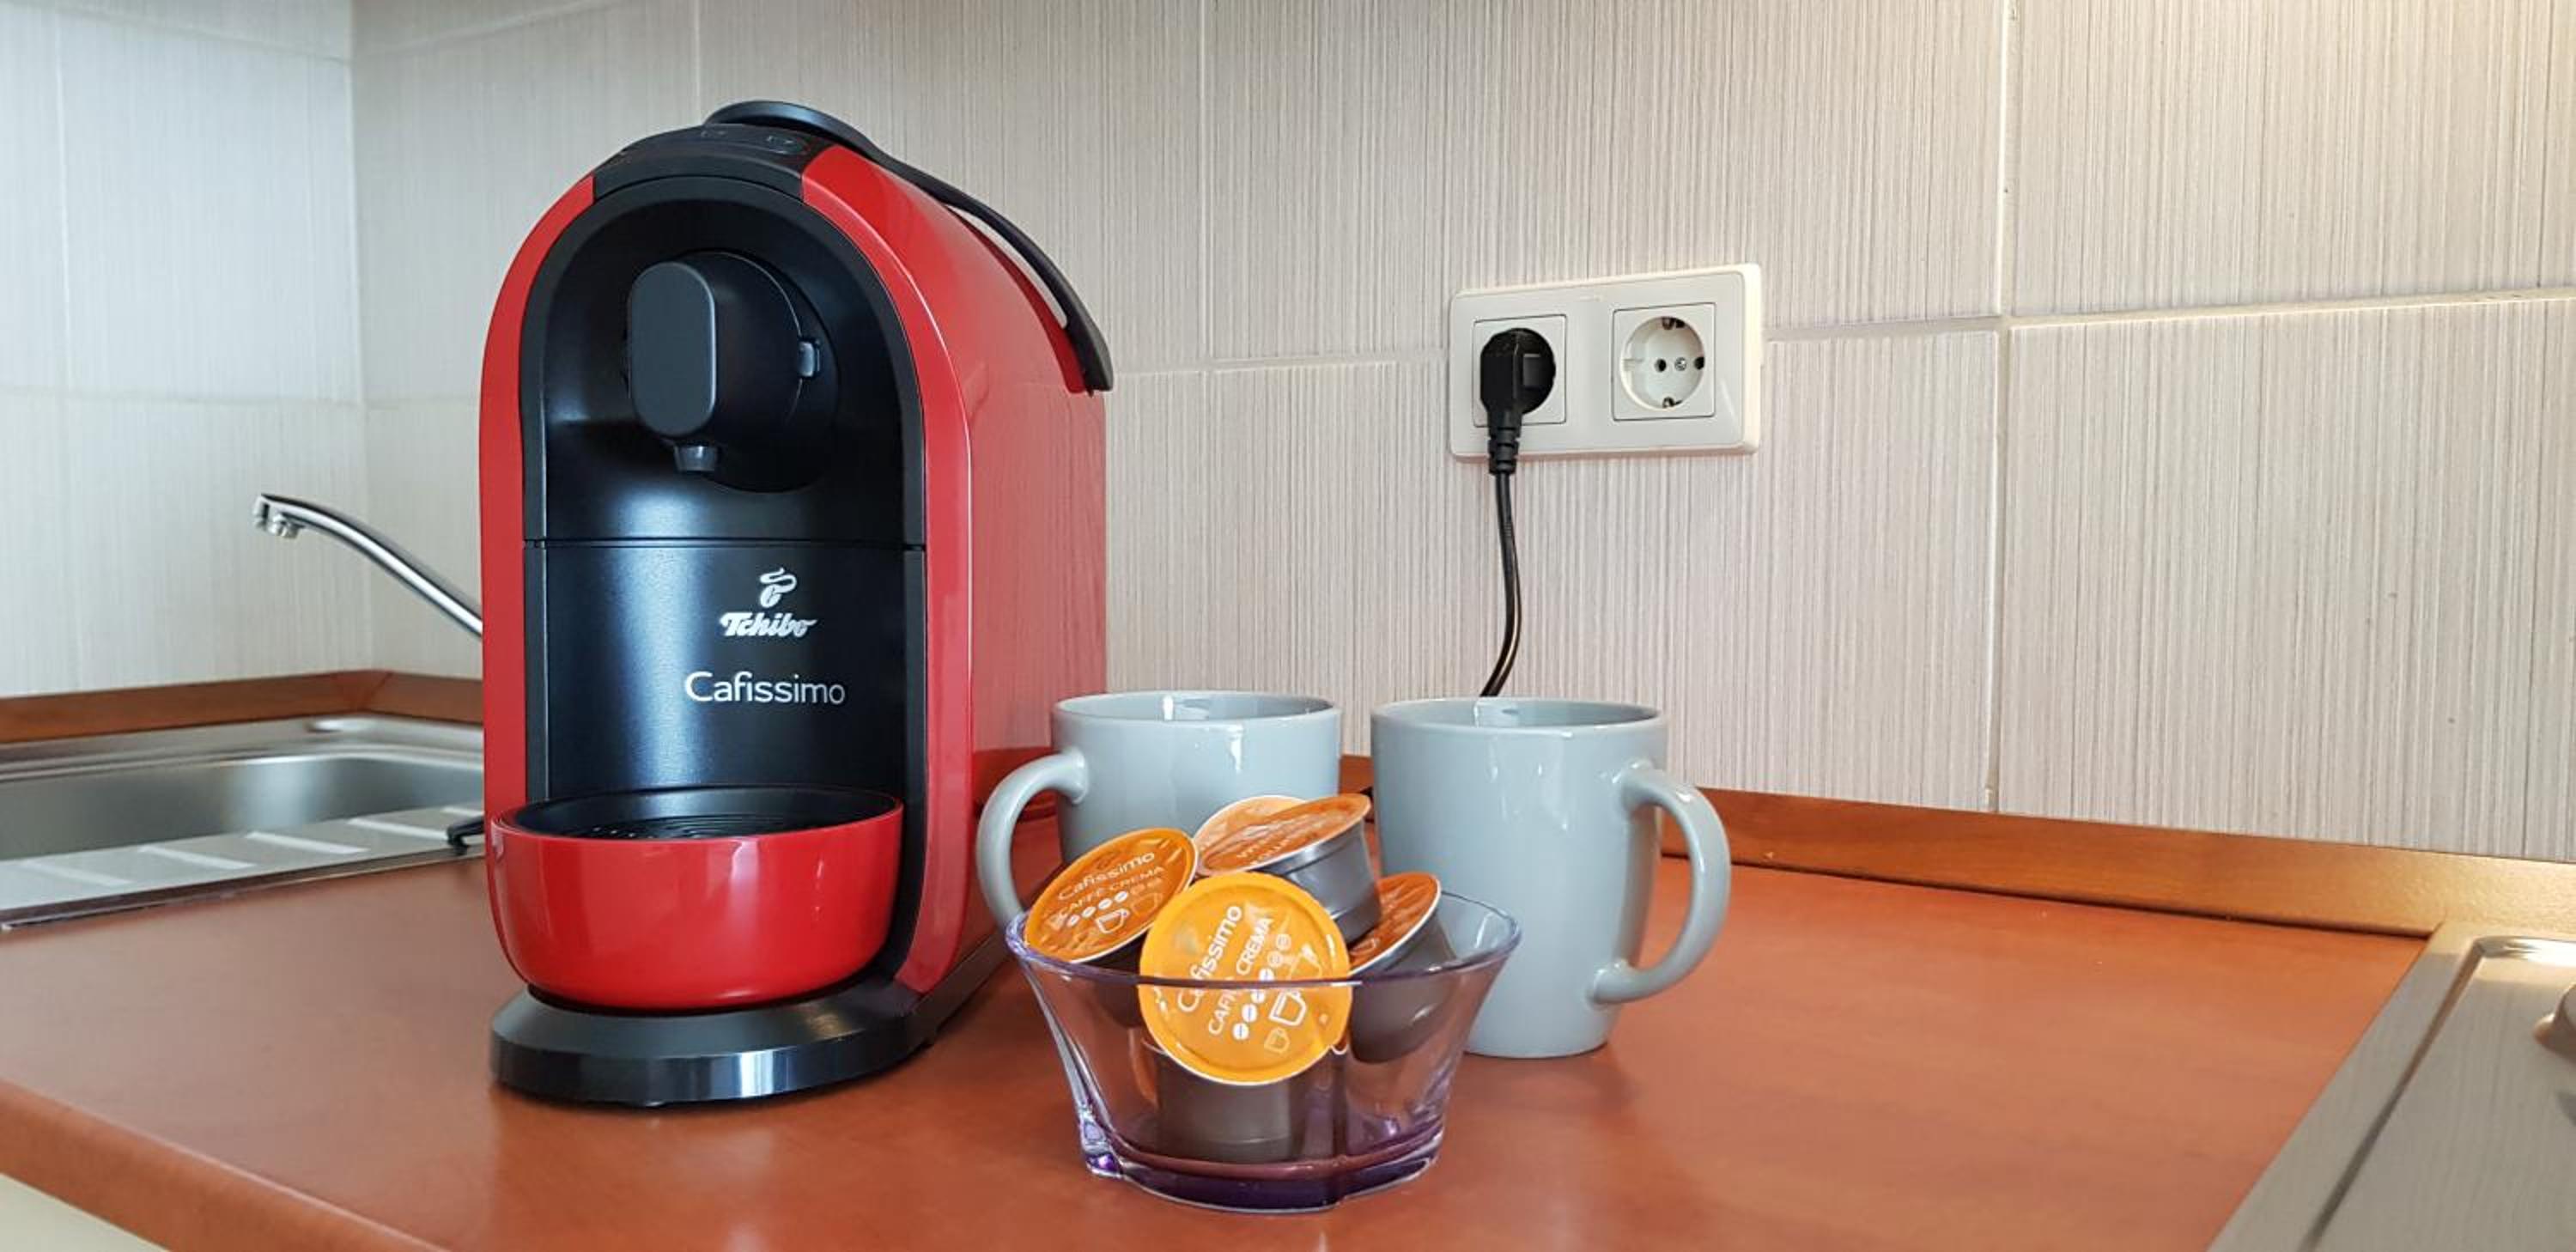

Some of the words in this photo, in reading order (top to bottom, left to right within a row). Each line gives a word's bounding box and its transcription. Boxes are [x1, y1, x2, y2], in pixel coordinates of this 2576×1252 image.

[720, 612, 817, 637] Tchibo
[685, 671, 846, 704] Cafissimo
[1058, 852, 1155, 901] Cafissimo
[1236, 917, 1275, 976] CREMA
